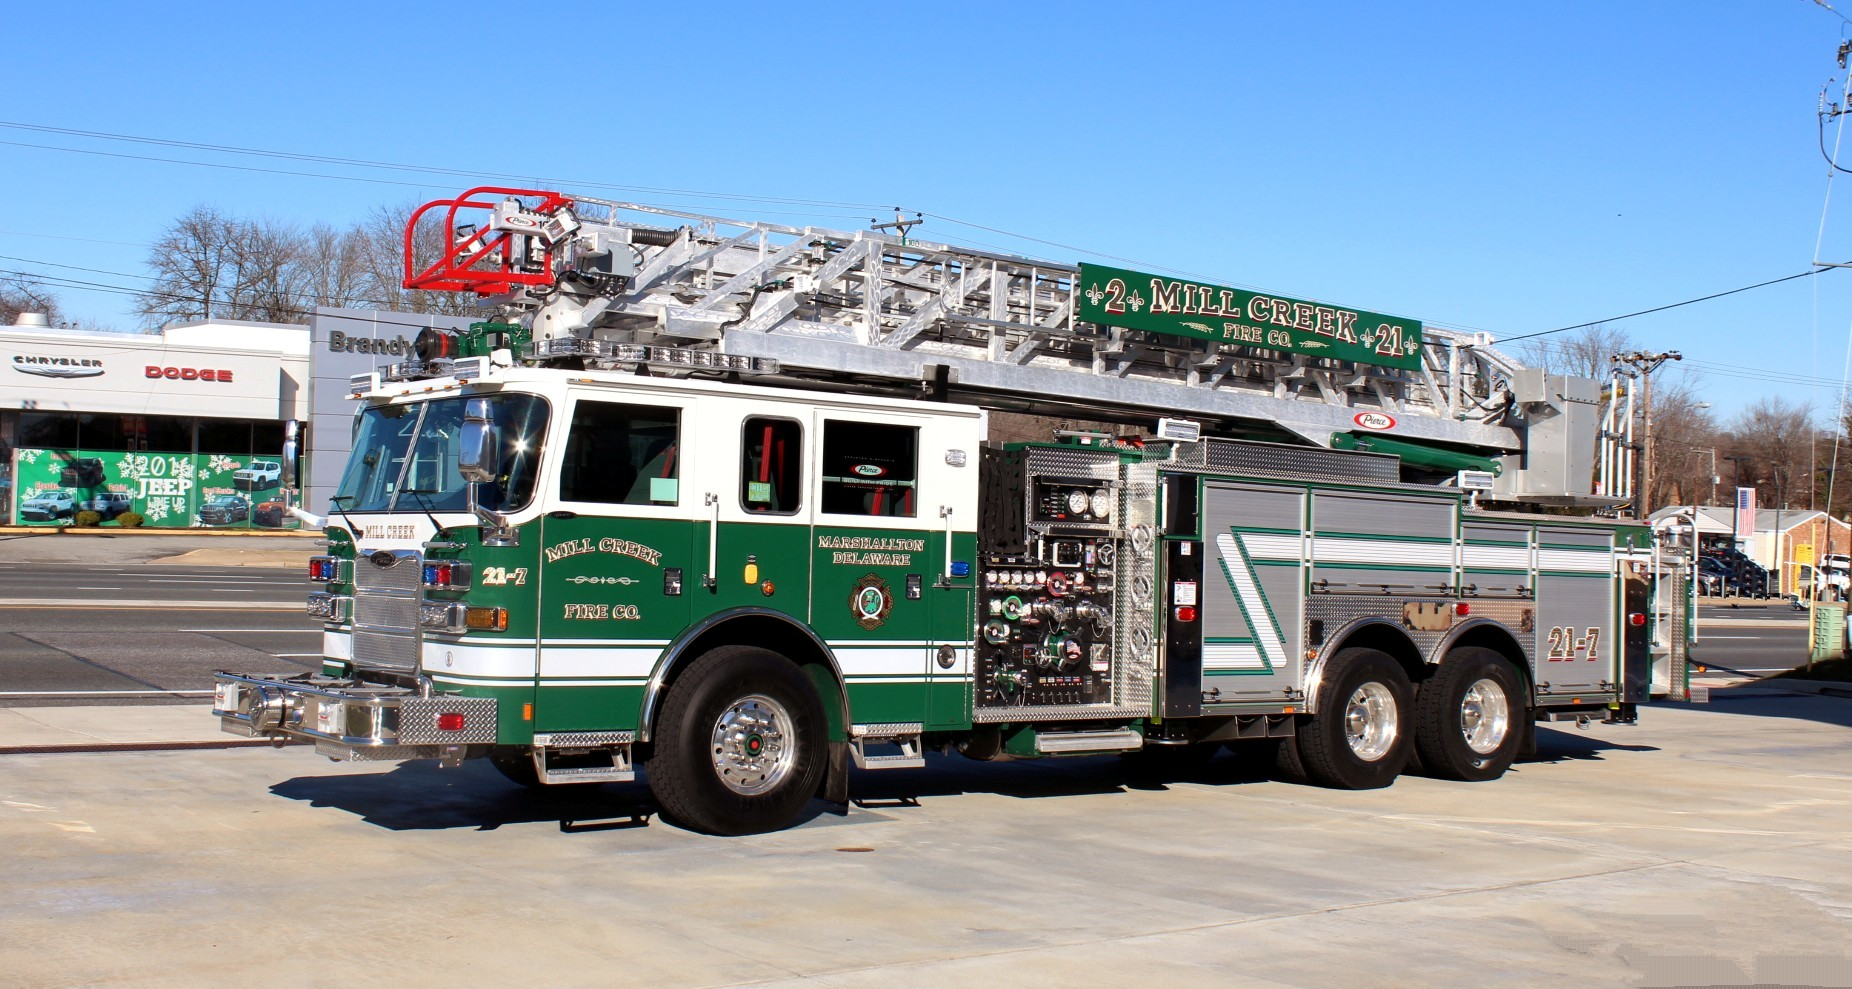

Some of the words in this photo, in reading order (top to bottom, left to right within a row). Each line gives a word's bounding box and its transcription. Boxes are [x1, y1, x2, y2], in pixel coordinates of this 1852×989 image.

[1105, 278, 1126, 315] 2
[1150, 279, 1241, 318] MILL
[1247, 295, 1358, 344] CREEK
[1375, 323, 1404, 357] 21
[1223, 322, 1262, 344] FIRE
[1267, 329, 1293, 348] CO.
[13, 355, 103, 368] CHRYSLER
[145, 365, 234, 383] DODGE
[1363, 414, 1387, 426] Pierce
[858, 465, 879, 474] Pierce
[137, 478, 193, 499] JEEP
[365, 525, 385, 539] MILL
[387, 525, 415, 540] CREEK
[545, 538, 595, 563] MILL
[599, 537, 663, 566] CREEK
[818, 535, 924, 552] MARSHALLTON
[833, 551, 911, 566] DELAWARE
[482, 566, 528, 586] 21-7
[564, 604, 609, 620] FIRE
[612, 604, 641, 620] CO.
[1547, 626, 1601, 662] 21-7
